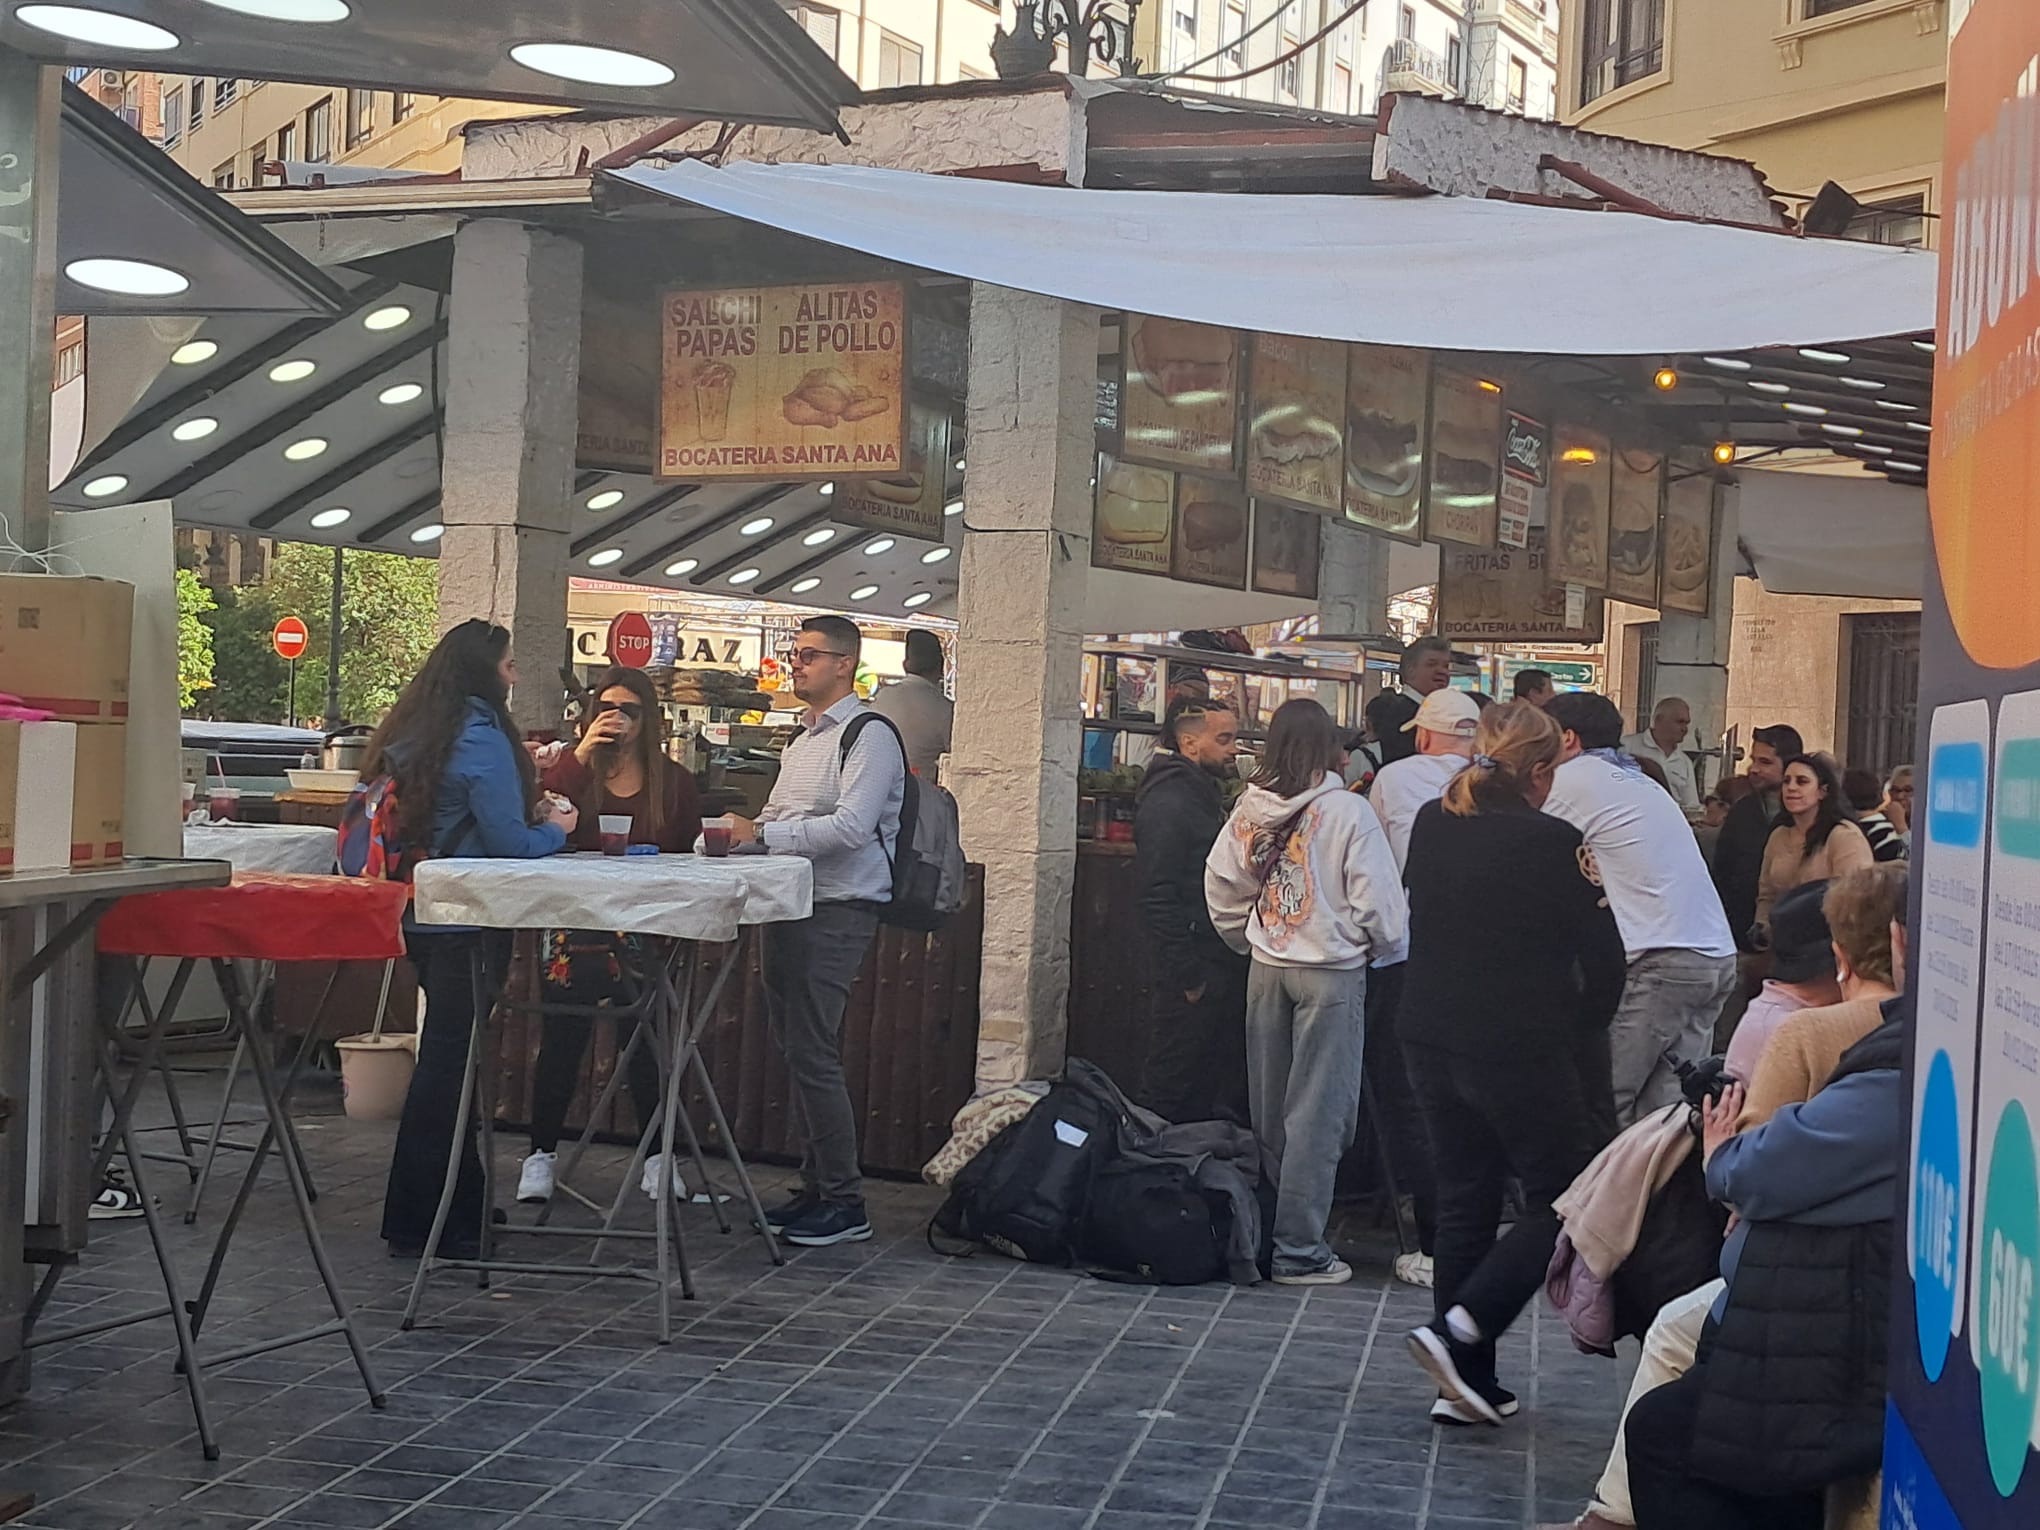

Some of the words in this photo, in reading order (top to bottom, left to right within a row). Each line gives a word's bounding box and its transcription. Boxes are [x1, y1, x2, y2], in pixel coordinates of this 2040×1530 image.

[1947, 53, 2040, 355] ABON
[796, 290, 878, 321] ALITAS
[676, 325, 757, 357] PAPAS
[778, 324, 808, 354] DE
[817, 320, 896, 352] POLLO
[1995, 351, 2012, 415] DE
[665, 445, 778, 467] BOCATERIA
[782, 444, 848, 464] SANTA
[852, 443, 897, 463] ANA
[1455, 554, 1511, 571] FRITAS
[619, 635, 650, 649] STOP
[1445, 621, 1517, 633] BOCATERIA
[1520, 621, 1563, 633] SANTA
[1988, 1227, 2032, 1394] 60€
